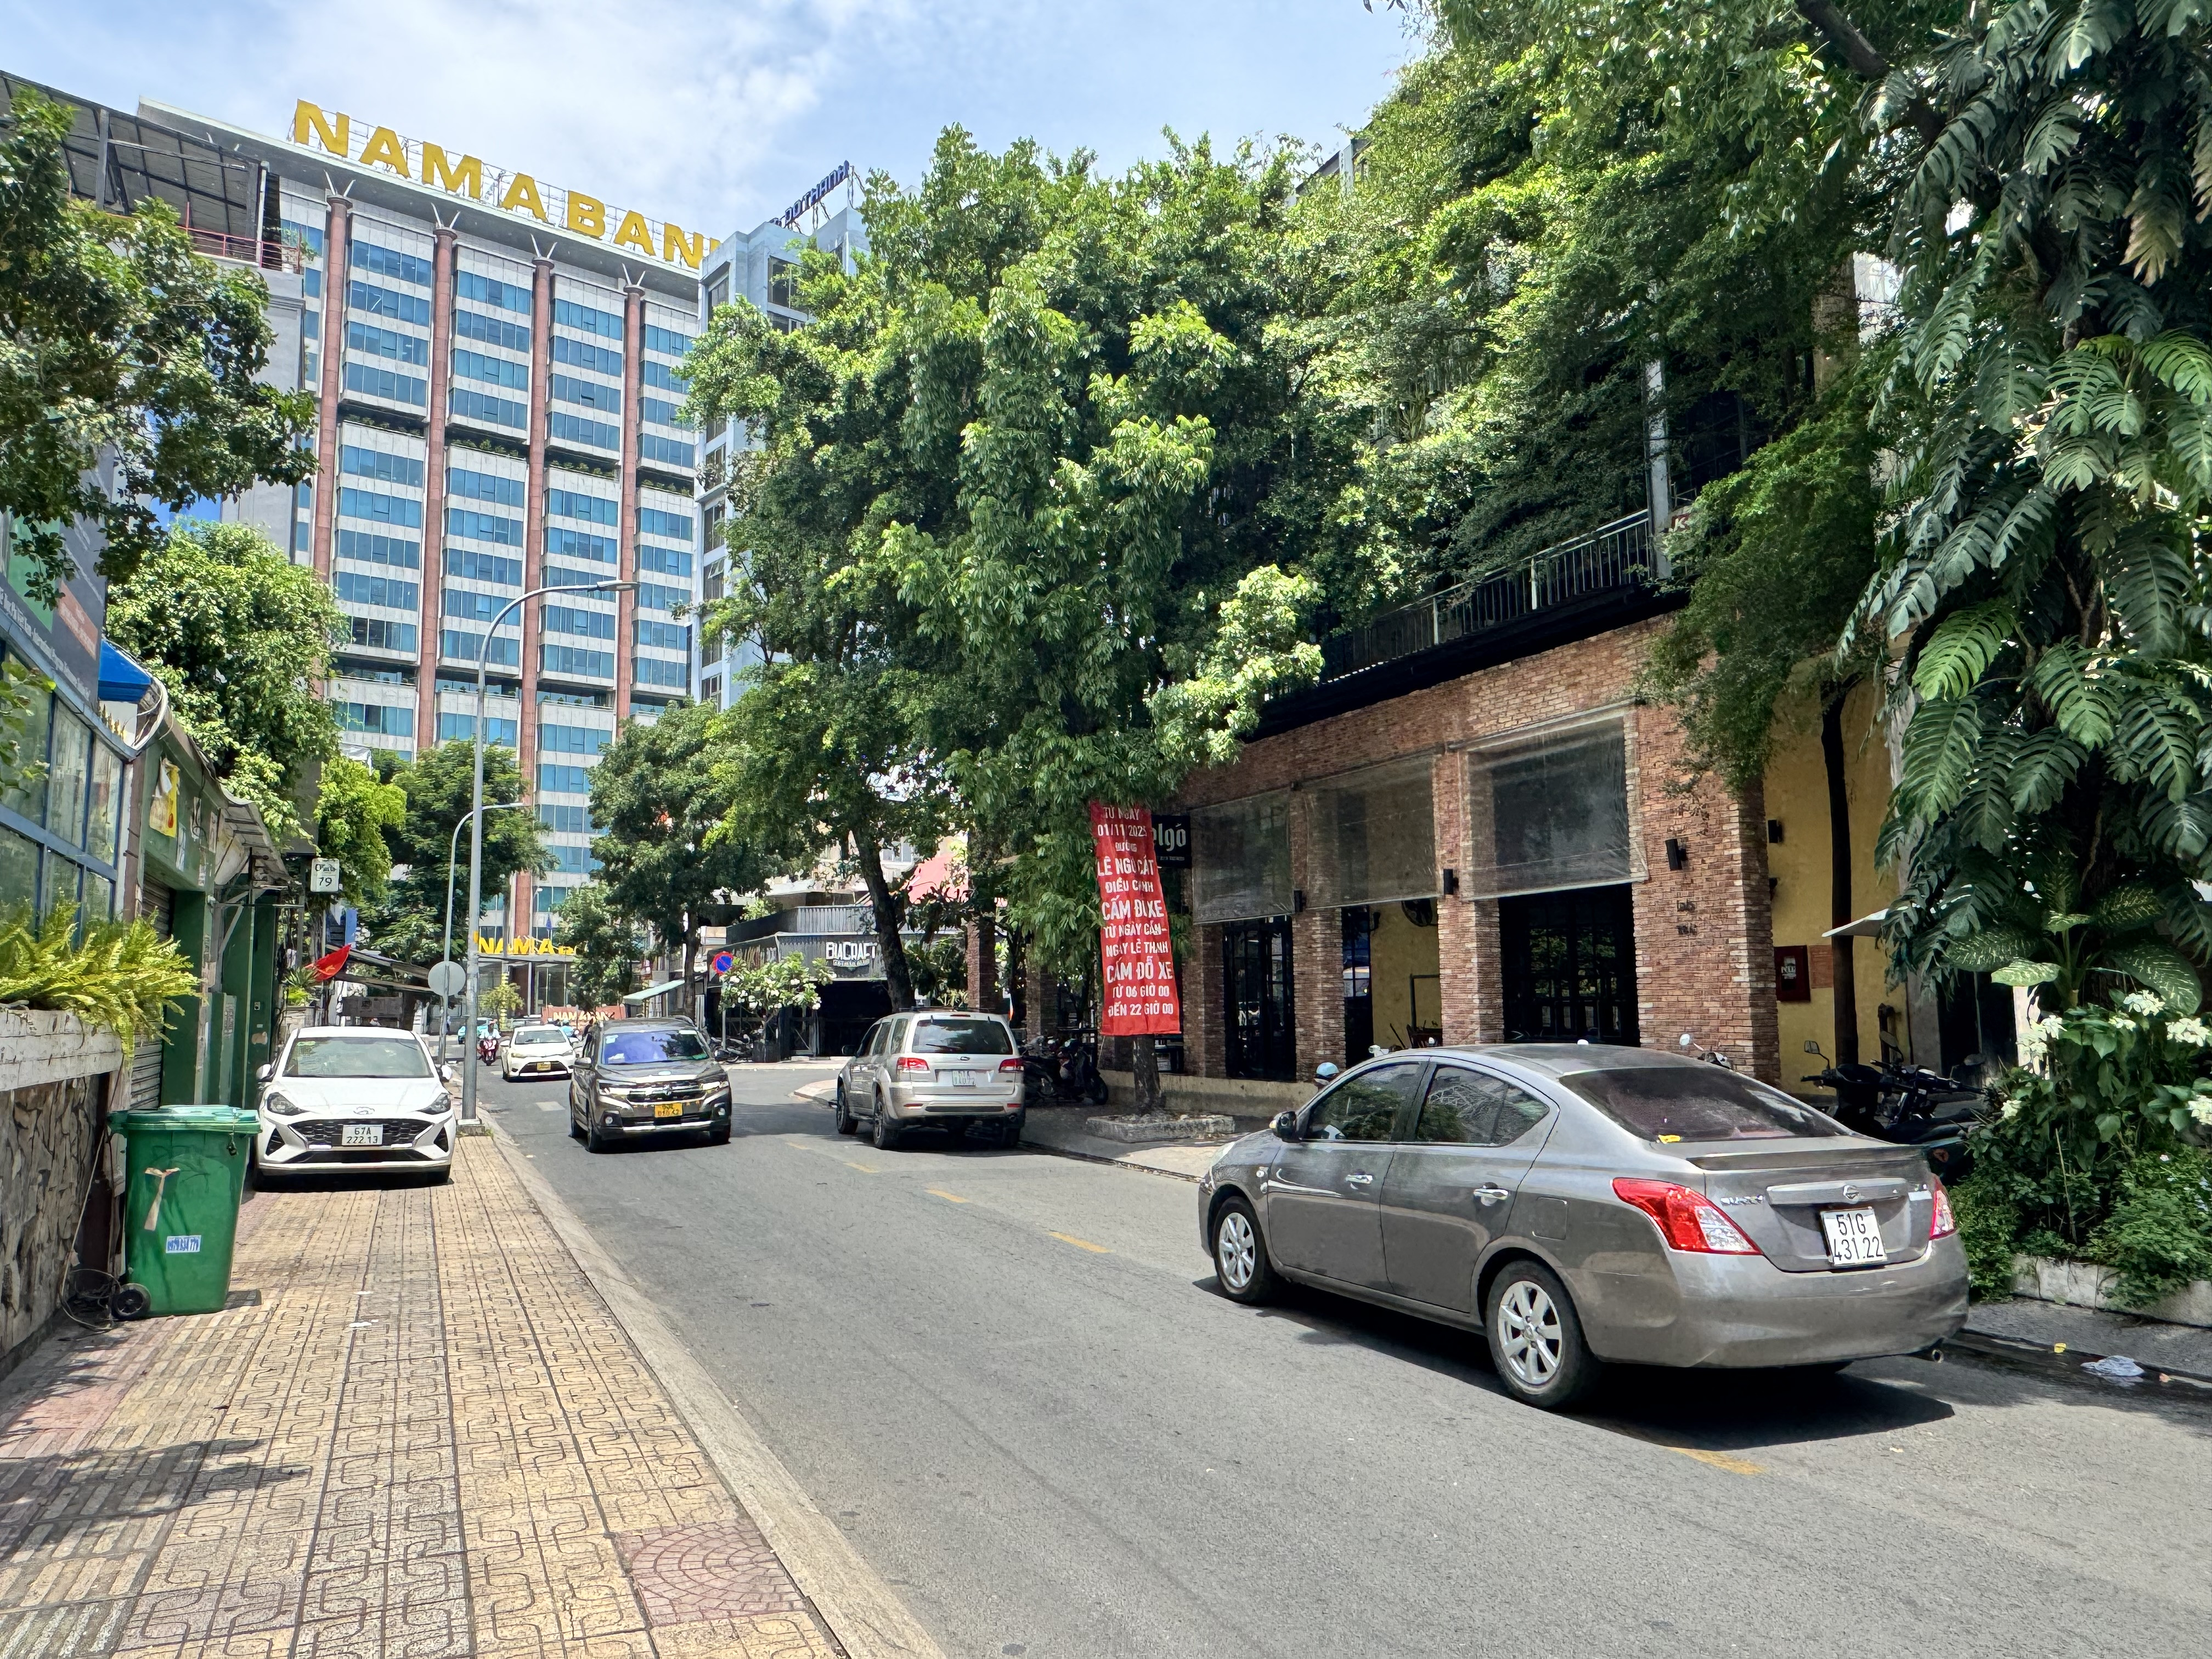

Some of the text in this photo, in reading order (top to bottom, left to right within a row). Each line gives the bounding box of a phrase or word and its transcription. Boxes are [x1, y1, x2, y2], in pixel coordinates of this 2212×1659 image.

[294, 99, 482, 199] NAM
[500, 172, 549, 223] A
[319, 877, 332, 887] 79
[1158, 961, 1173, 979] XE
[1158, 985, 1170, 997] 00
[1130, 1003, 1142, 1015] 22
[1836, 1212, 1866, 1236] 51G
[1833, 1235, 1883, 1261] 431.22
